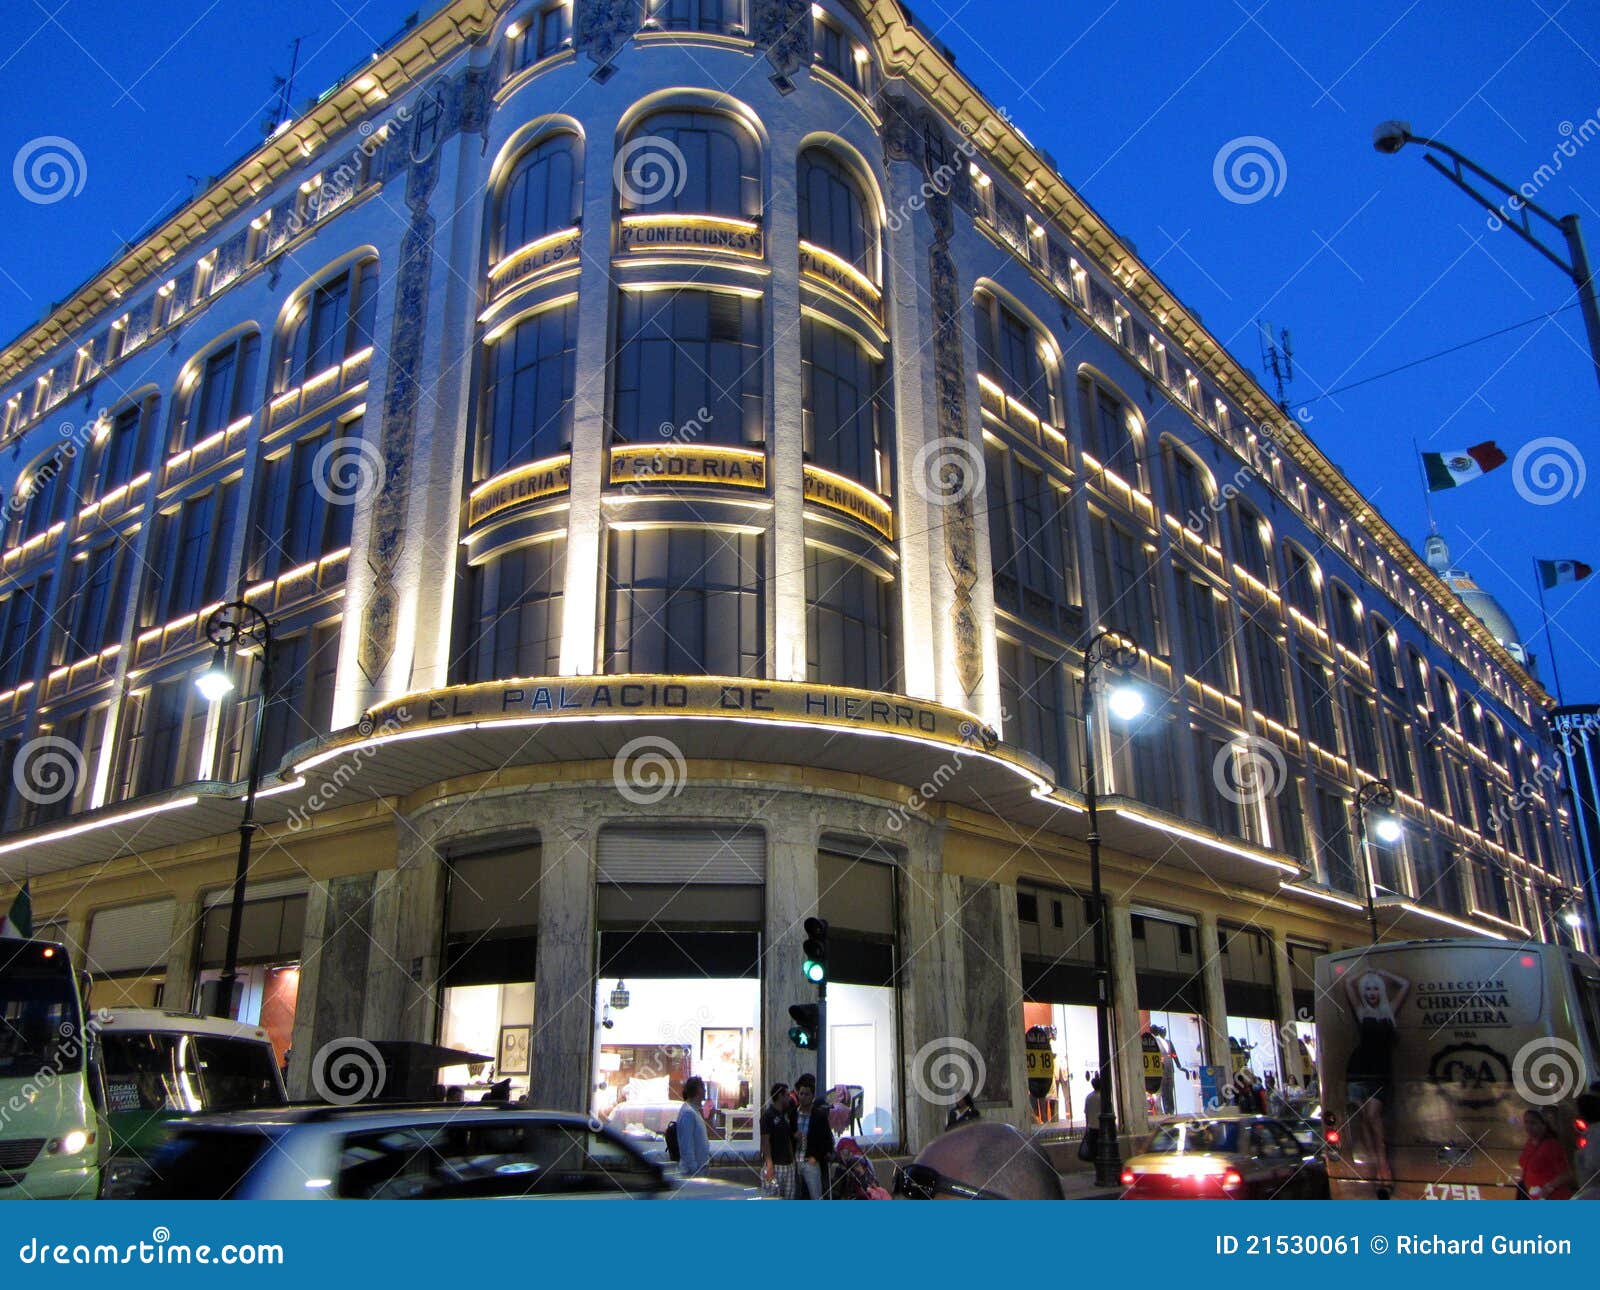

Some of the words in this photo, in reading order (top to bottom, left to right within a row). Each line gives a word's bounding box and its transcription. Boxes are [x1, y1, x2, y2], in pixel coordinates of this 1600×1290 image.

[636, 227, 746, 249] CONFECCIONES
[633, 456, 743, 479] SEDERIA
[427, 696, 473, 721] EL
[502, 684, 688, 712] PALACIO
[720, 686, 774, 712] DE
[806, 692, 936, 732] HIERRO
[1416, 994, 1510, 1009] CHRISTINA
[1422, 1011, 1508, 1025] AGUILERA
[1040, 1052, 1051, 1068] 18
